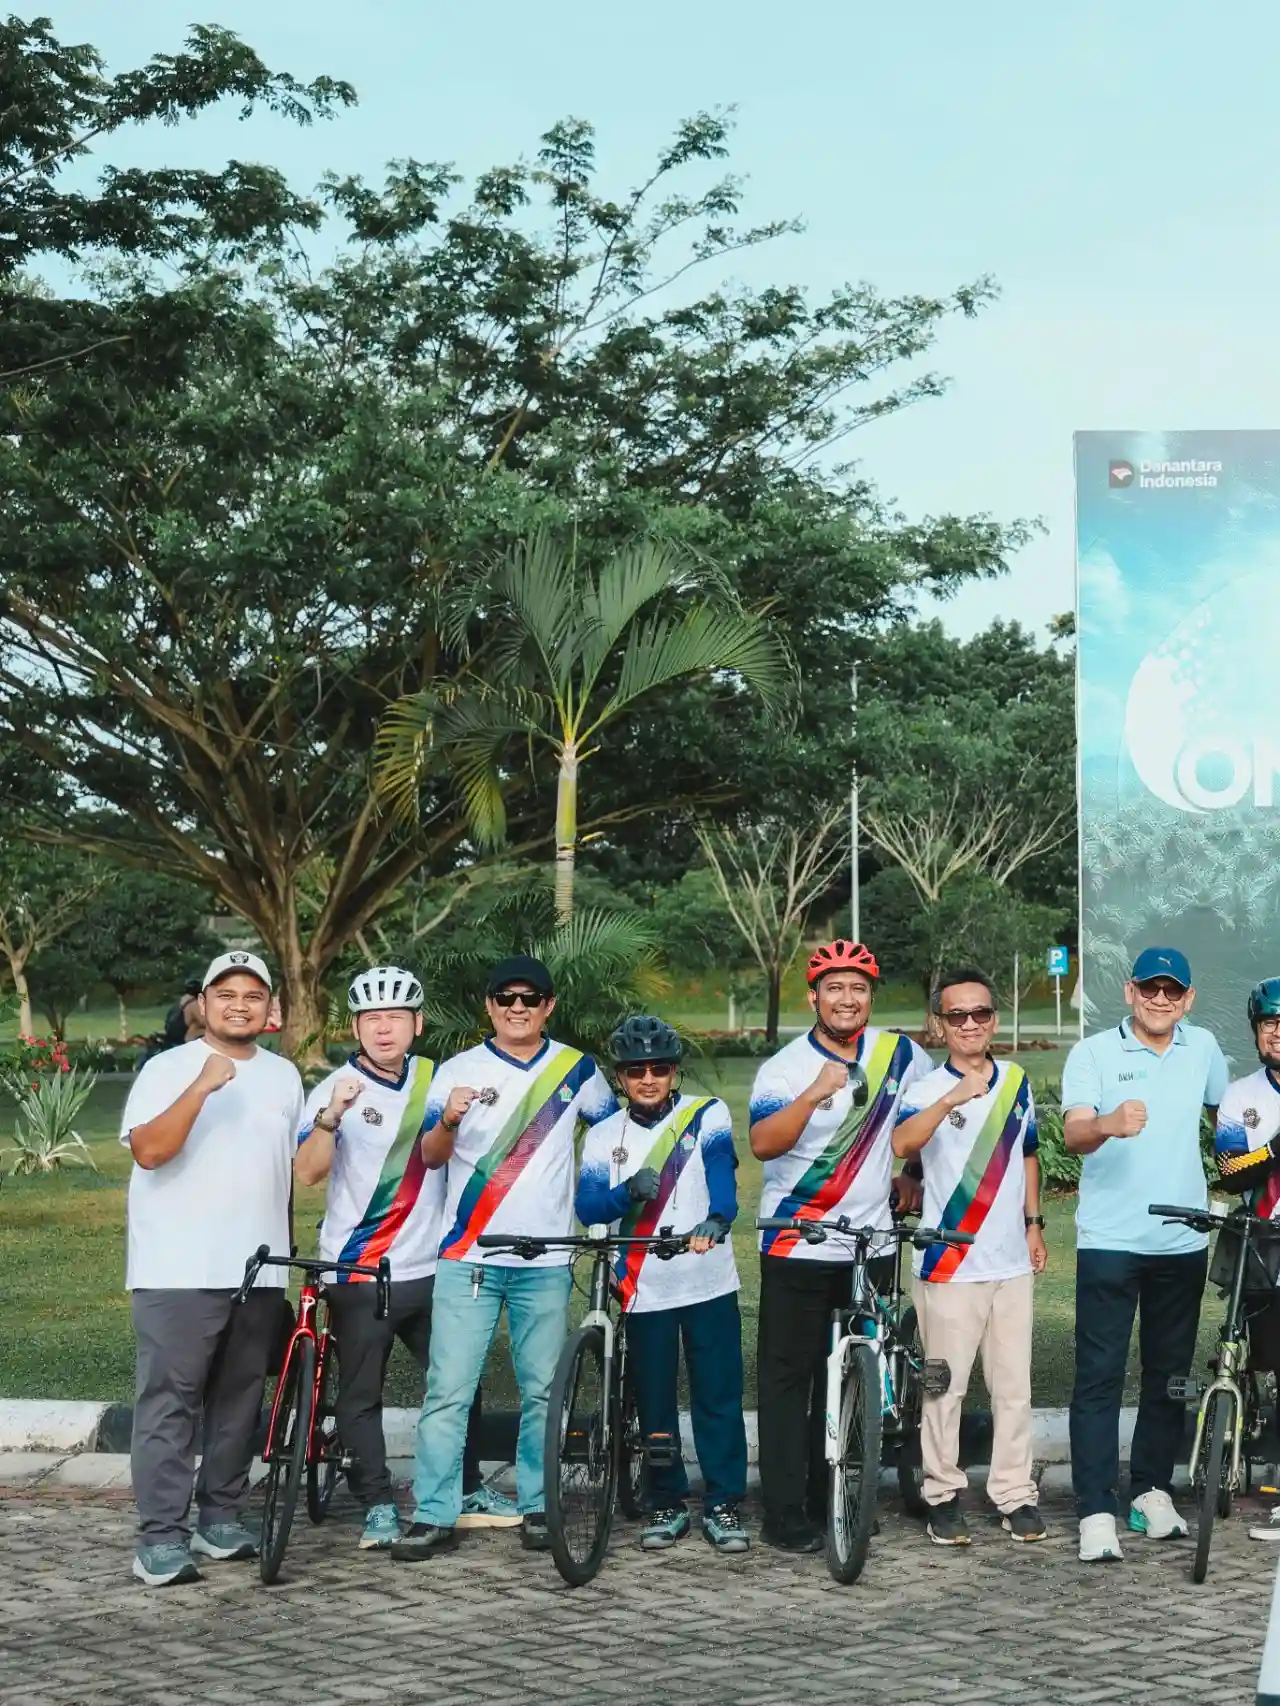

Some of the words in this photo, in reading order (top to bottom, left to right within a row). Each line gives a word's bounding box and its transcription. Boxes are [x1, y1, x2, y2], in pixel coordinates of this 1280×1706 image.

[1140, 460, 1222, 473] Danantara
[1140, 473, 1217, 488] Indonesia
[1051, 950, 1063, 964] P
